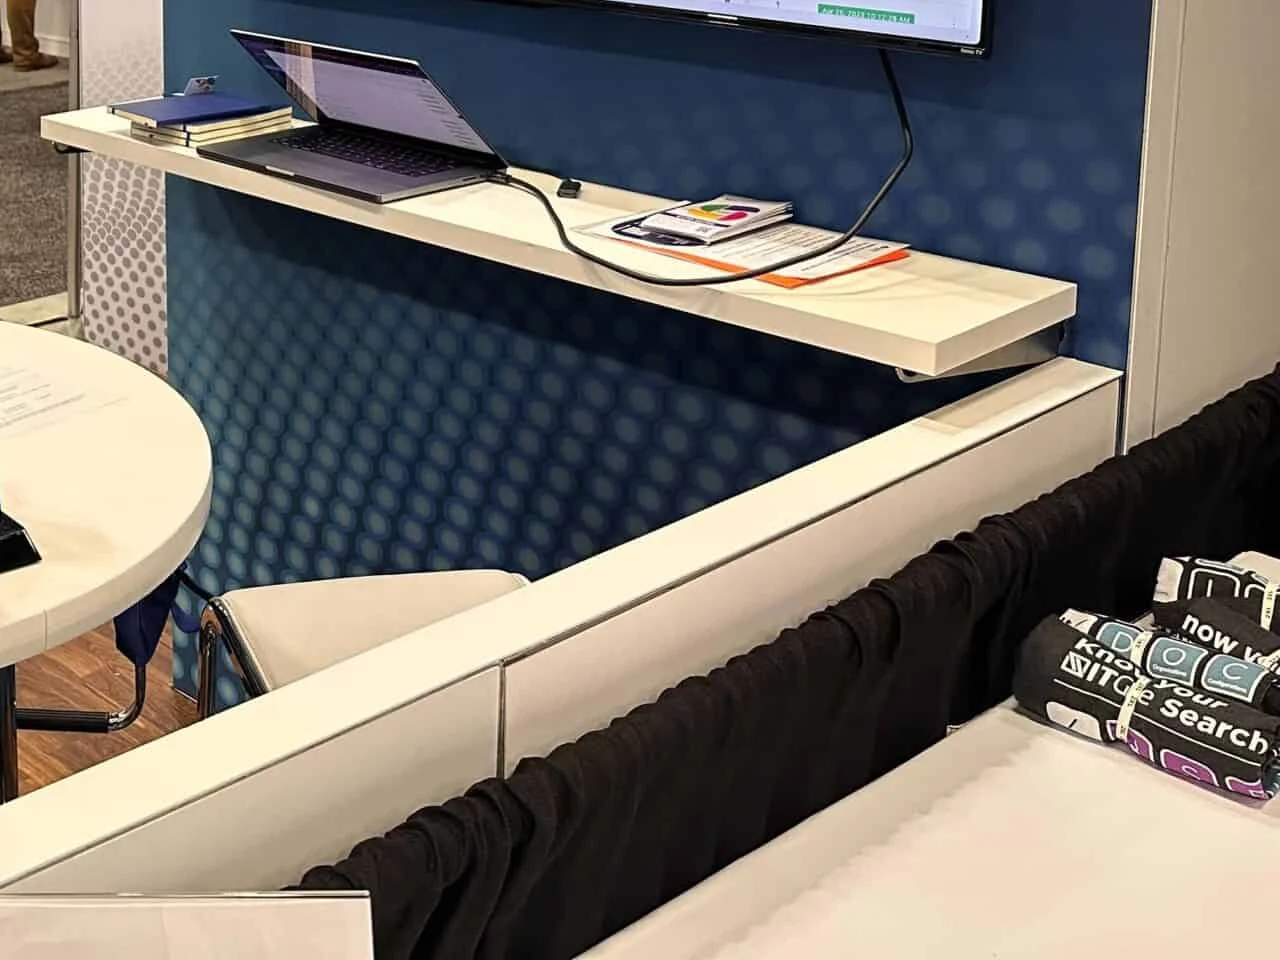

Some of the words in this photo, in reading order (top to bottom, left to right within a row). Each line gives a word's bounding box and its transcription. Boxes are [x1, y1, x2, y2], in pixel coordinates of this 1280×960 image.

[1163, 647, 1186, 666] O
[1222, 662, 1249, 680] C
[1153, 678, 1229, 710] your
[1160, 698, 1269, 756] Search
